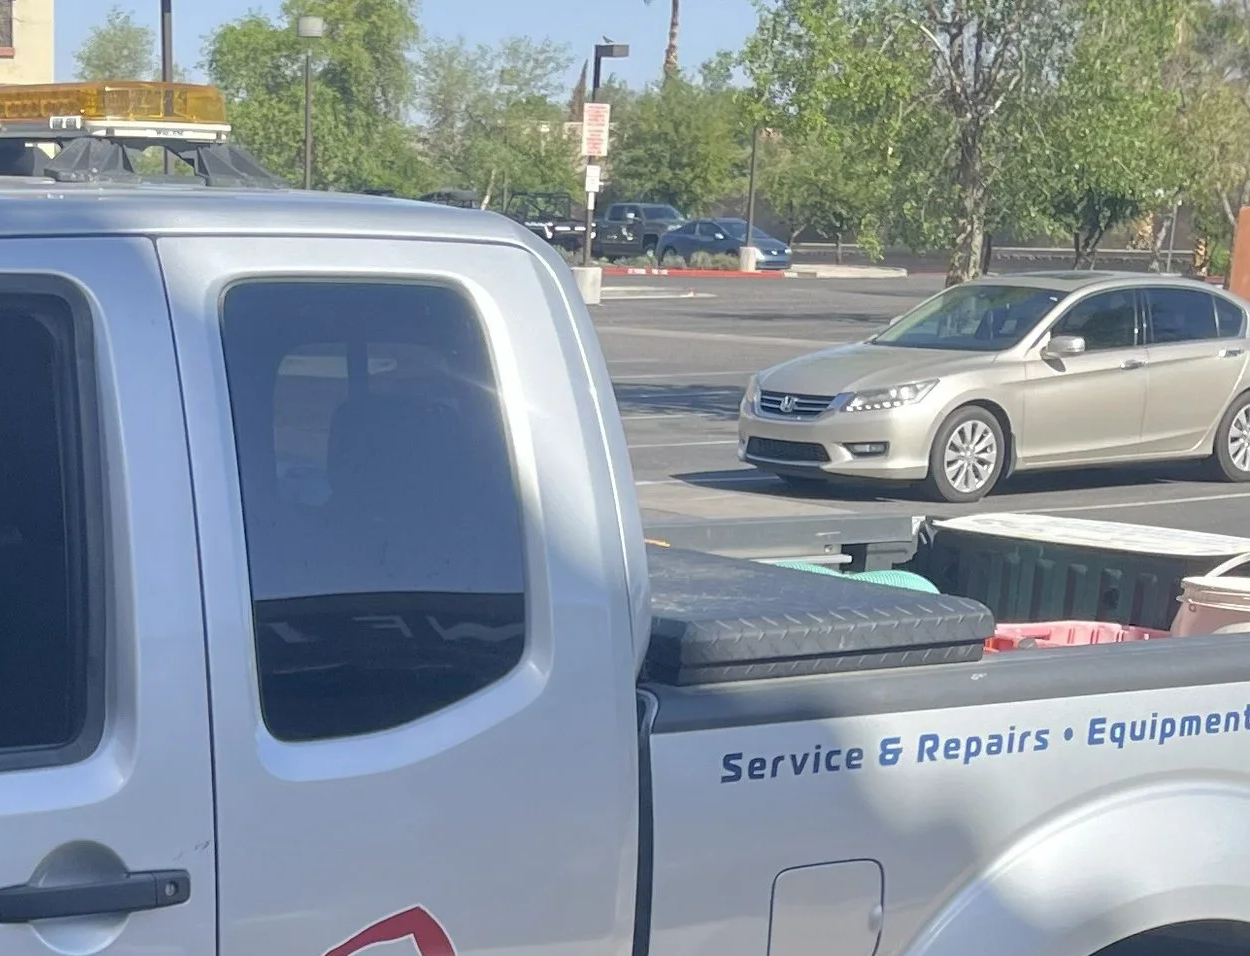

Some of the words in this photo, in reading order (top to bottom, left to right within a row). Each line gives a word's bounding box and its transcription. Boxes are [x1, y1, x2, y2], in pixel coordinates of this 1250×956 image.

[720, 744, 864, 783] Service
[878, 736, 903, 767] &
[916, 725, 1050, 765] Repairs
